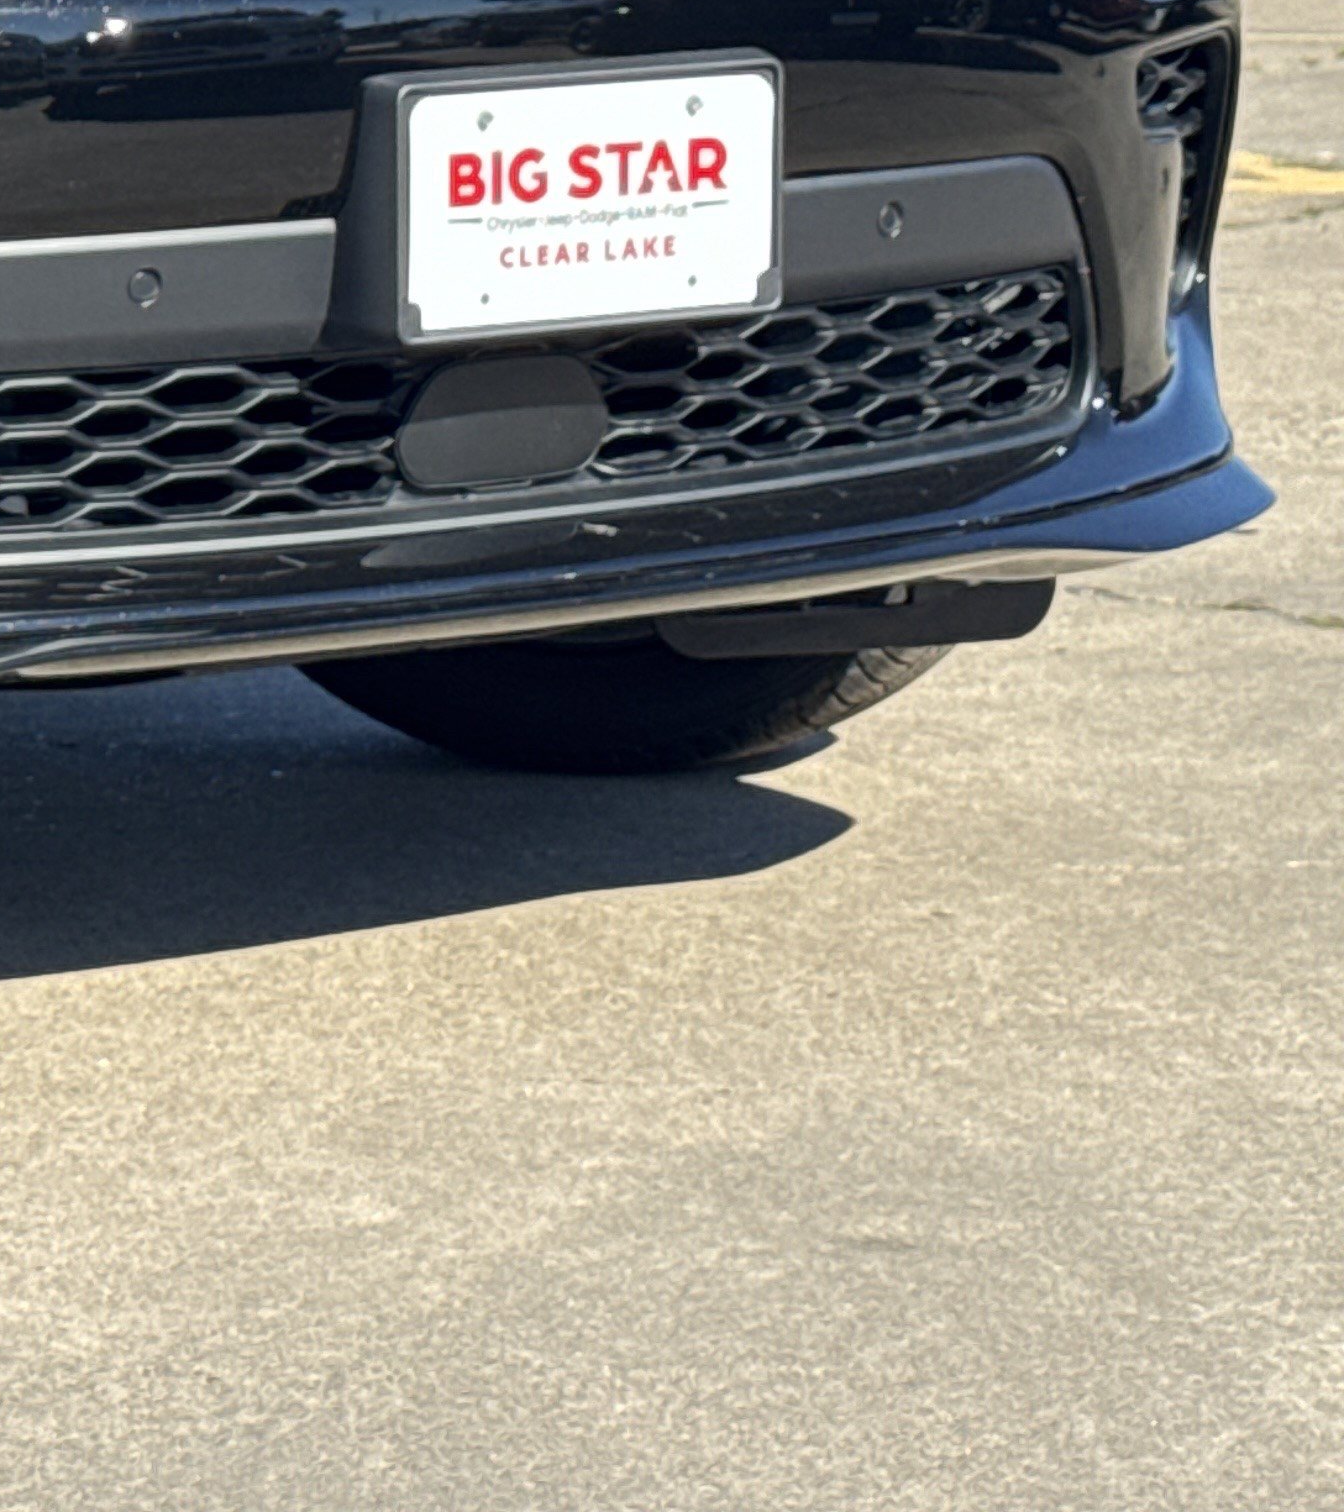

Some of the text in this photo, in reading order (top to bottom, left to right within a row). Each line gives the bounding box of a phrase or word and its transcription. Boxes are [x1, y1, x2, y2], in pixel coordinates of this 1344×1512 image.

[447, 136, 728, 209] BIG STAR
[499, 234, 676, 269] CLEAR LAKE
